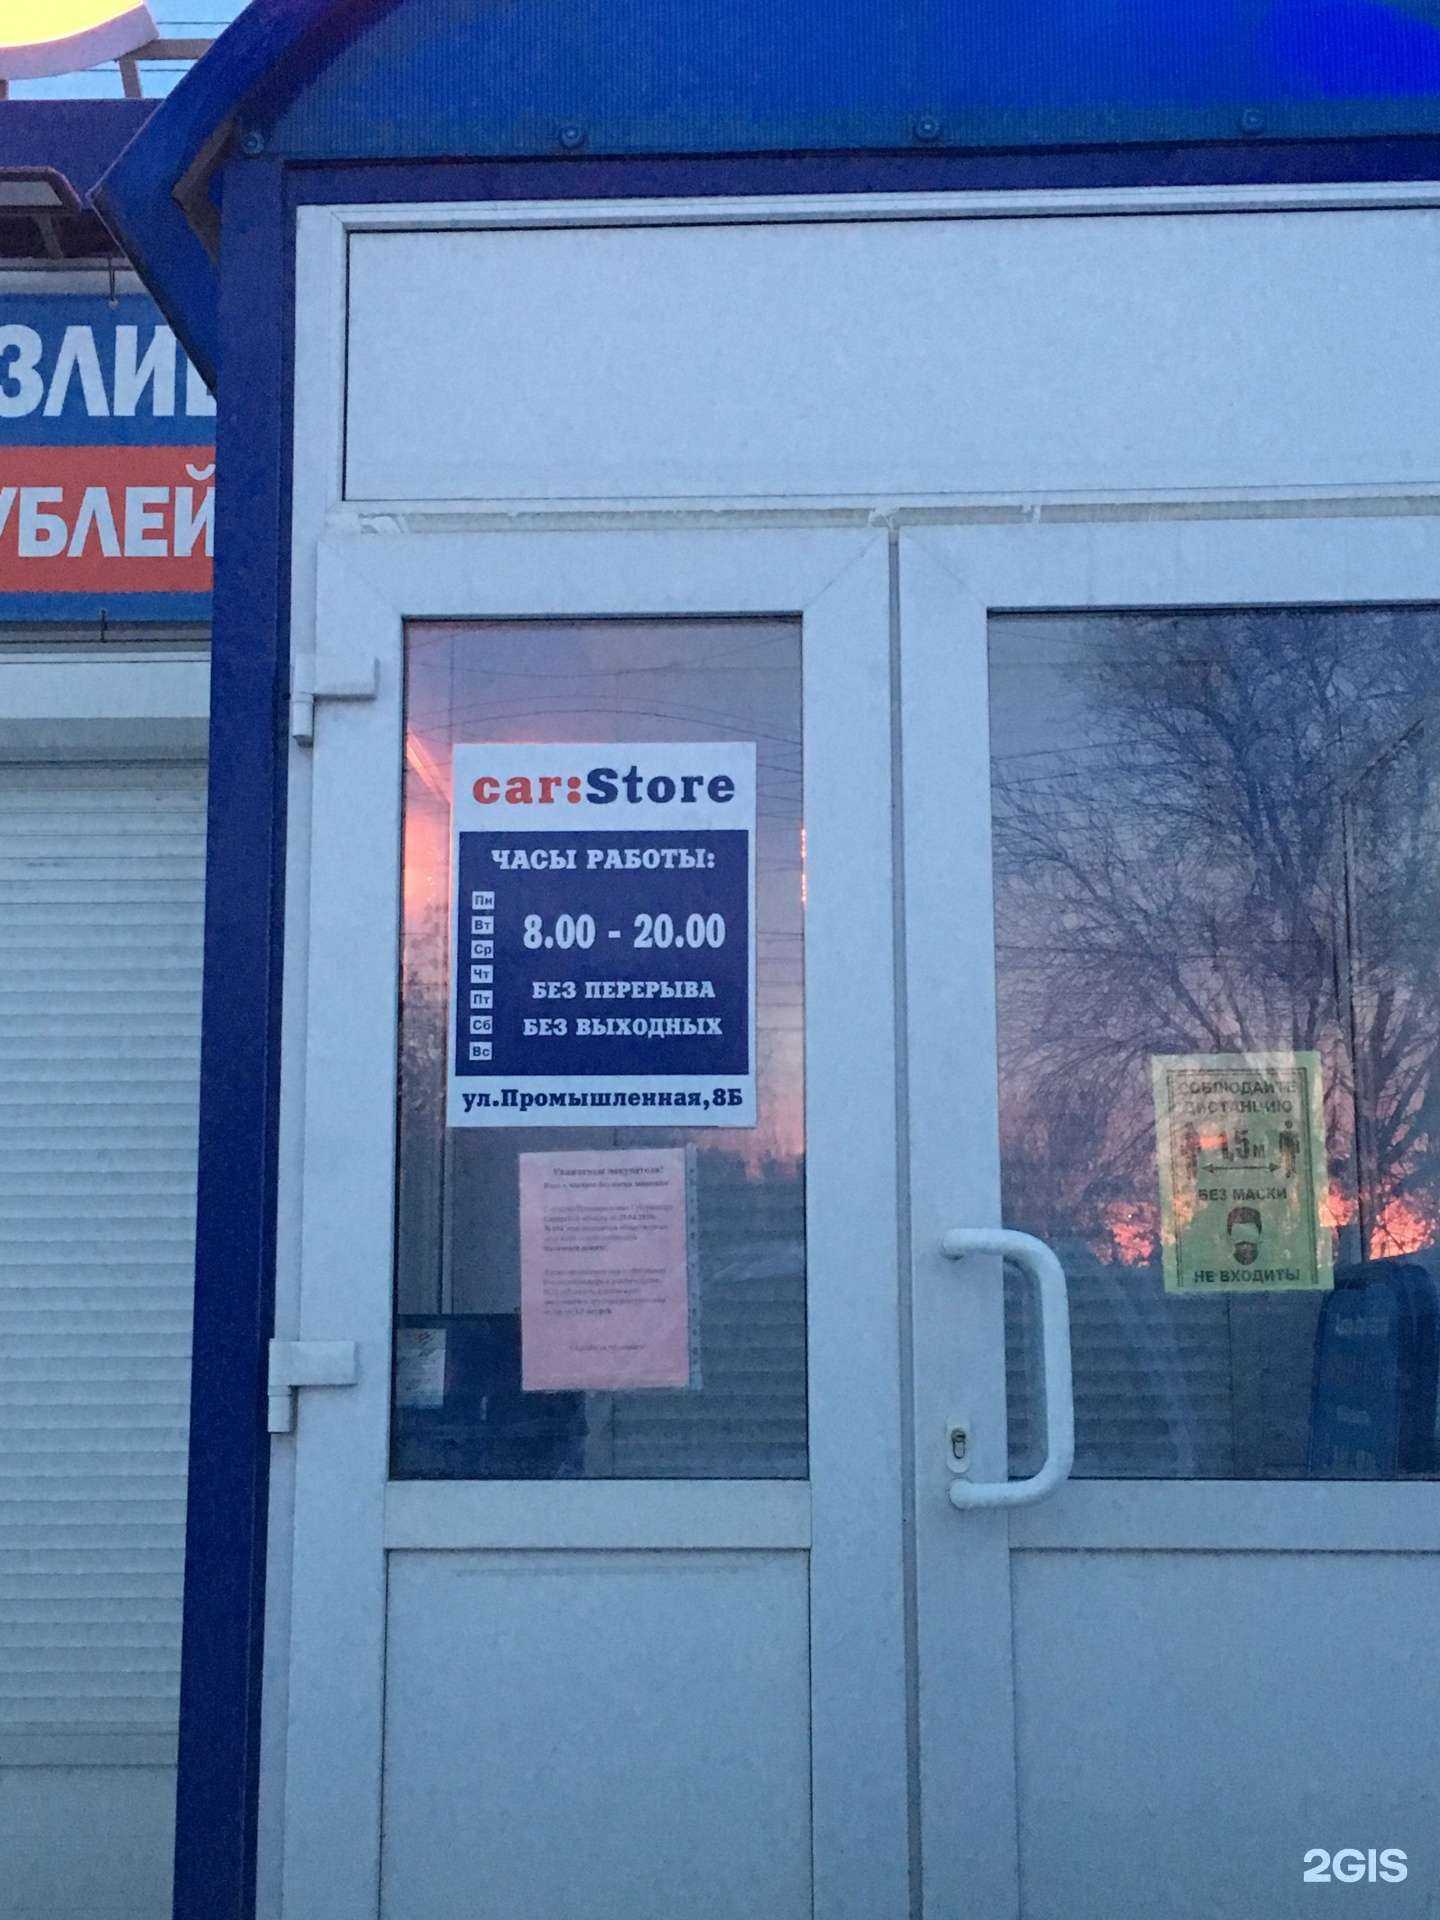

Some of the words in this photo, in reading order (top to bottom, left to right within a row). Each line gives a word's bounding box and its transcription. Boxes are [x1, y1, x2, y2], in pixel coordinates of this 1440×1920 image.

[472, 765, 735, 804] car:Store
[492, 849, 577, 870] ЧАСЫ
[586, 848, 716, 869] РАБОТЫ:
[474, 895, 493, 906] Пн
[474, 920, 491, 930] Вт
[523, 914, 596, 949] 8.00
[633, 913, 726, 948] 20.00
[474, 944, 492, 956] Ср
[473, 968, 489, 979] Чт
[532, 982, 576, 999] БЕЗ
[584, 981, 716, 999] ПЕРЕРЫВА
[473, 994, 490, 1005] Пт
[473, 1020, 491, 1031] Сб
[523, 1019, 568, 1036] БЕЗ
[575, 1017, 723, 1038] ВЫХОДНЫХ
[472, 1046, 490, 1057] Вс
[1198, 1188, 1227, 1201] БЕЗ
[1232, 1188, 1287, 1201] МАСКИ
[1194, 1270, 1218, 1283] НЕ
